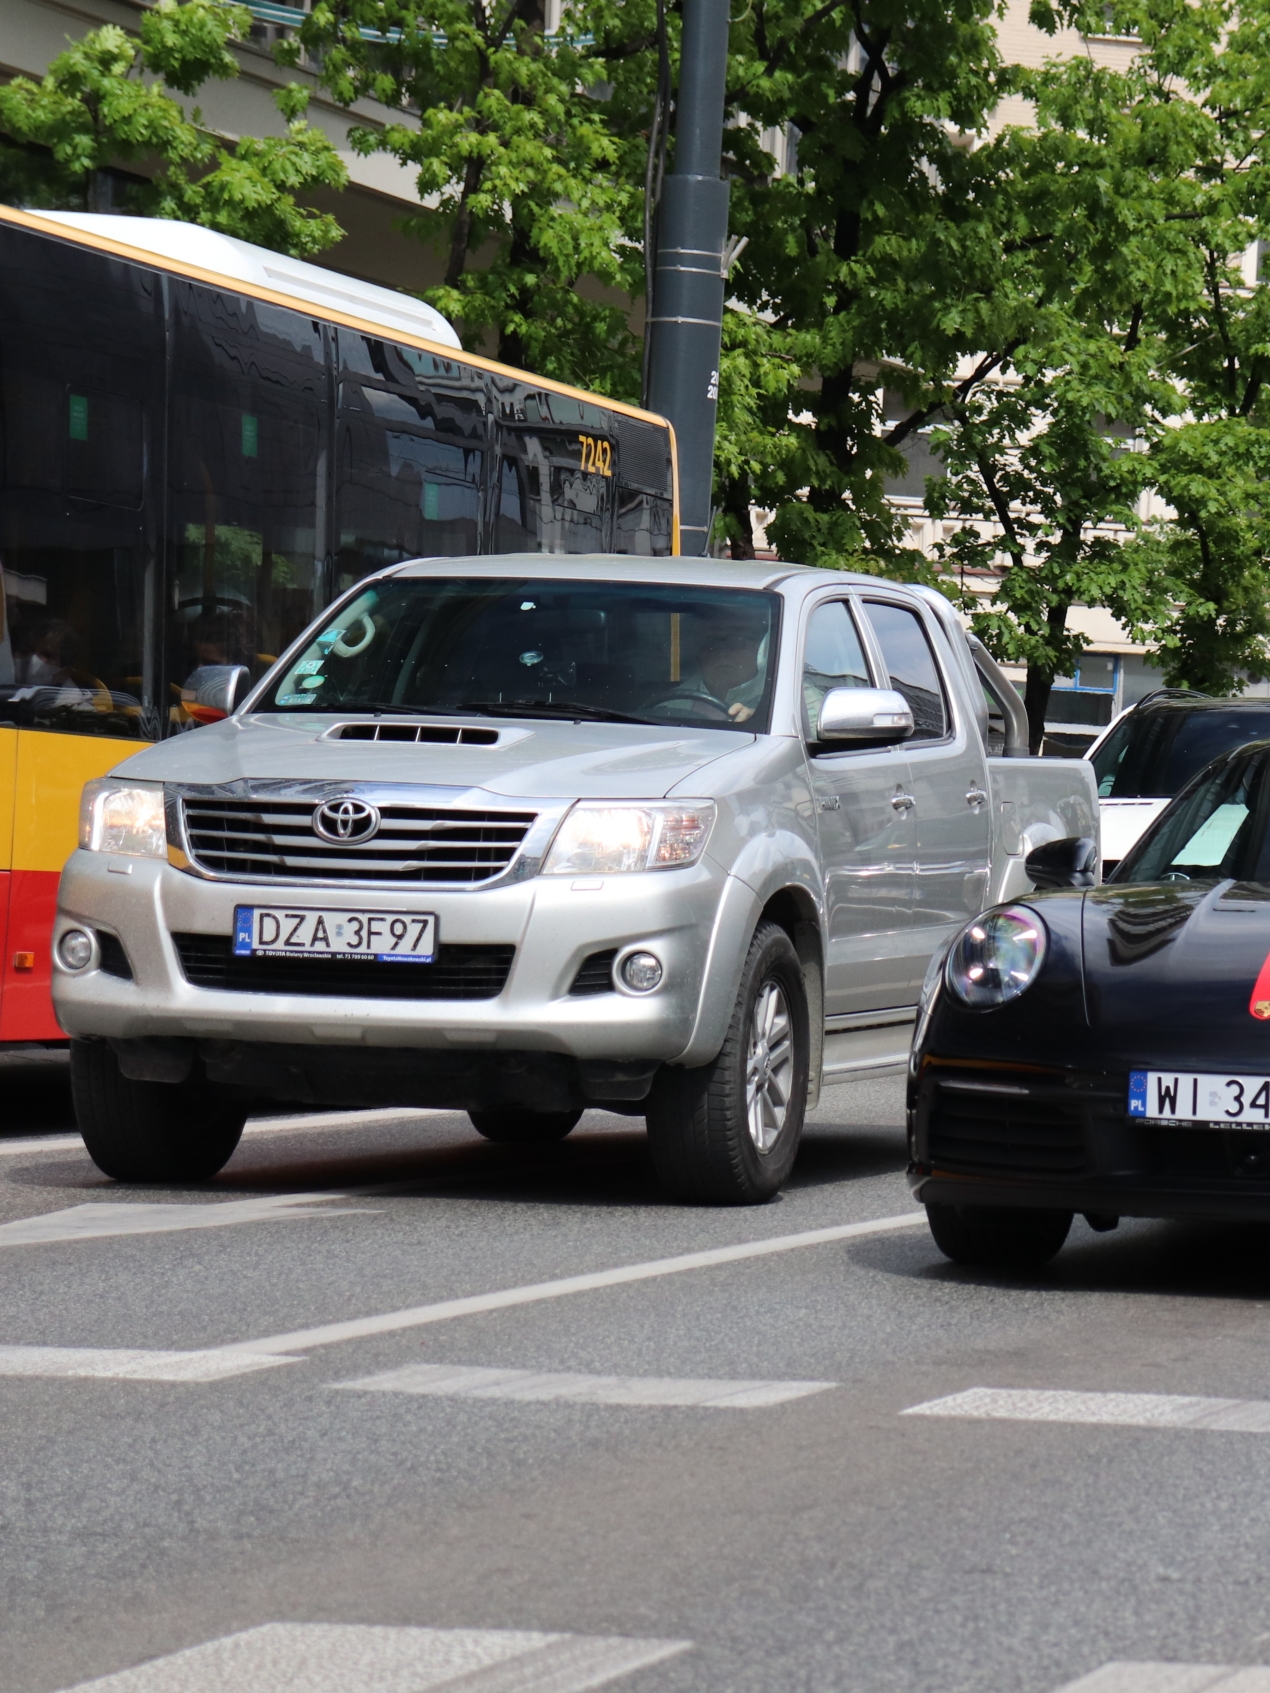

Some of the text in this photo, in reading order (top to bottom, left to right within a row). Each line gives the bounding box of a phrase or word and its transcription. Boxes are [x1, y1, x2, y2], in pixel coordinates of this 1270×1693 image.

[578, 434, 612, 477] 7242
[239, 932, 251, 942] PL
[258, 912, 430, 951] DZA 3F97
[1131, 1100, 1145, 1111] PL
[1157, 1076, 1198, 1116] WI
[1135, 1118, 1193, 1127] PORSCHE
